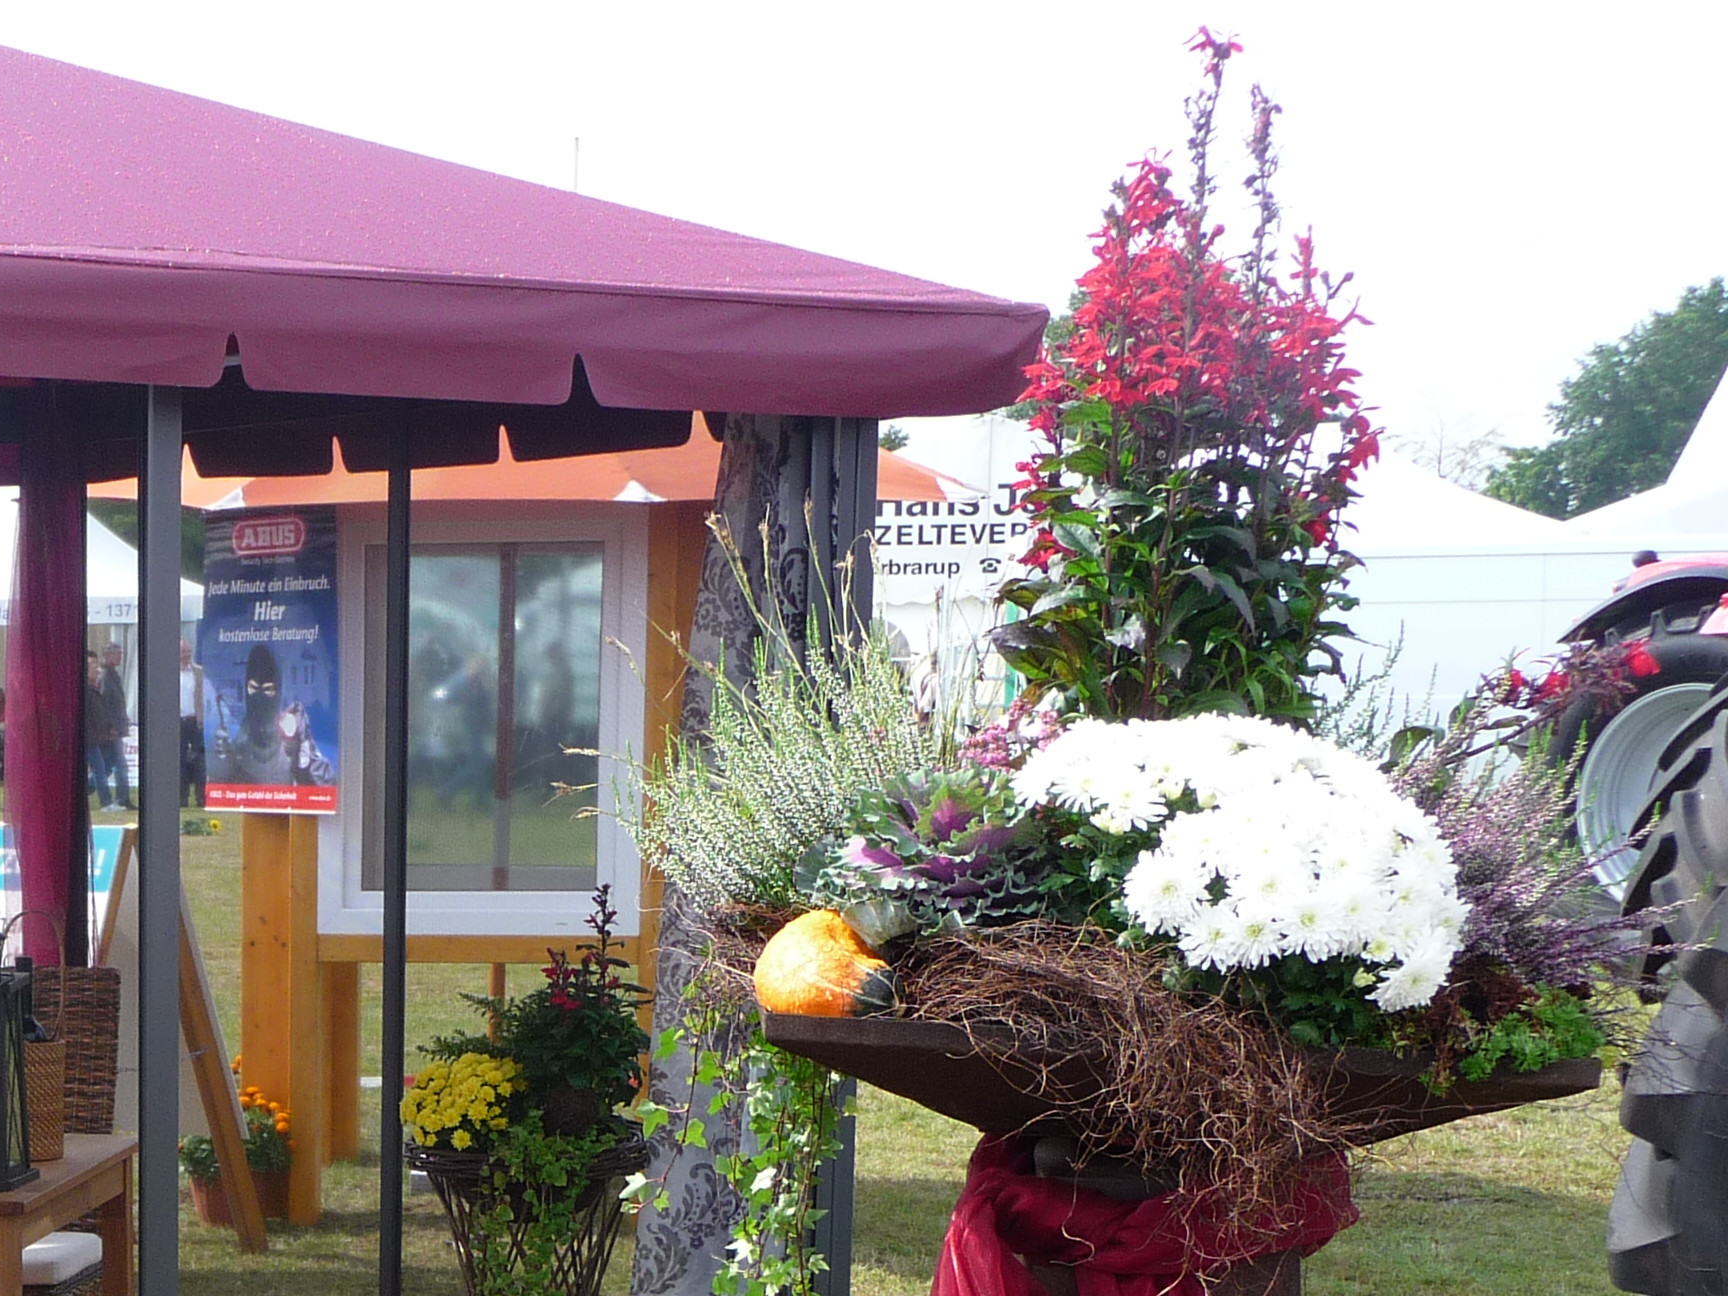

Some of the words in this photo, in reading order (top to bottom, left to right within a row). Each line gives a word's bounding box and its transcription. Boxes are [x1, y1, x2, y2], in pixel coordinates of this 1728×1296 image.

[241, 524, 296, 548] ABUS
[873, 558, 961, 579] rbrarup
[208, 580, 229, 598] Jede
[230, 579, 266, 595] Minute
[268, 577, 283, 592] ein
[284, 574, 331, 591] Einbruch.
[254, 600, 287, 621] Hier
[218, 627, 270, 643] kostenlose
[272, 624, 319, 644] Beratung!
